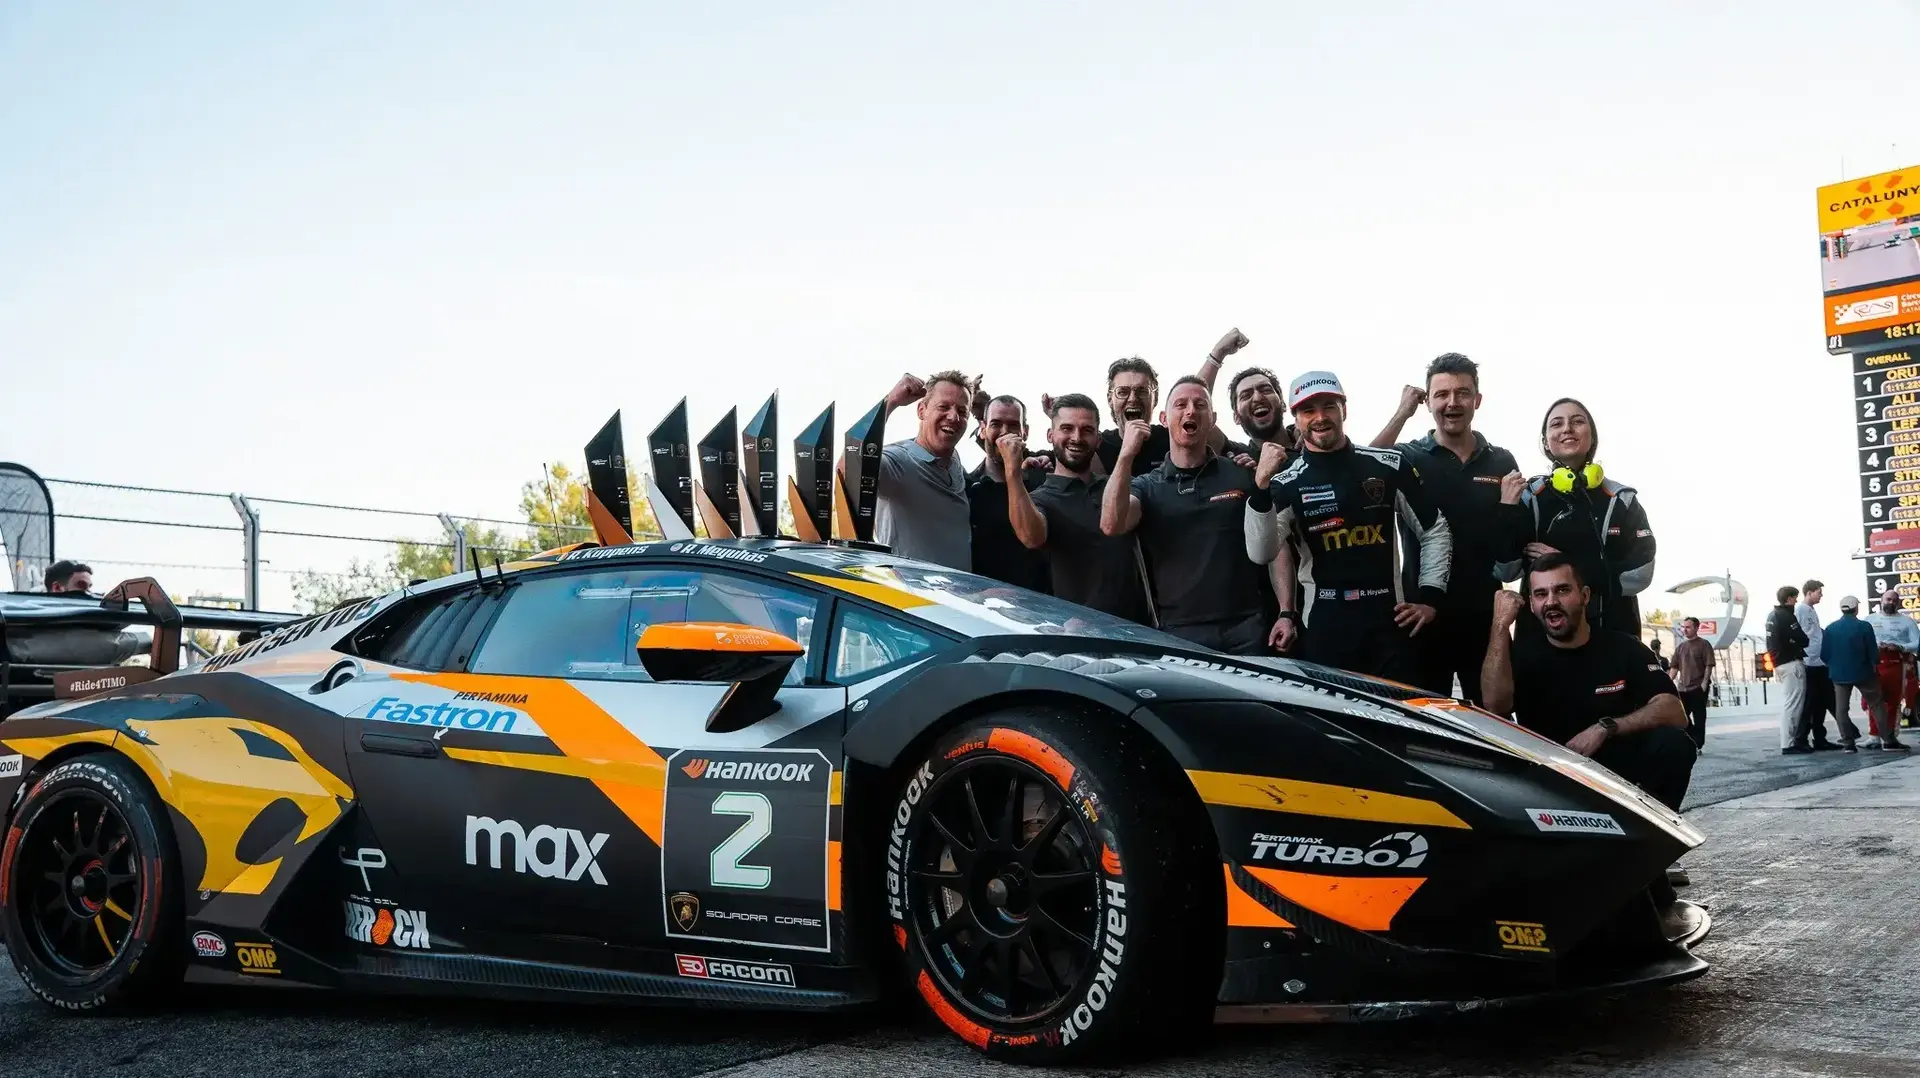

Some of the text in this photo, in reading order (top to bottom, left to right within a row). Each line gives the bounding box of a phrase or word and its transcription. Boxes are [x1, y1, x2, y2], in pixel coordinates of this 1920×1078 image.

[1865, 352, 1911, 366] OVERALL
[1886, 366, 1917, 380] ORU
[1863, 377, 1872, 392] 1
[1892, 392, 1915, 405] ALI
[1864, 402, 1876, 418] 2
[1892, 418, 1918, 430] LEF
[1865, 427, 1877, 442] 3
[1866, 452, 1879, 467] 4
[1868, 477, 1881, 493] 5
[1304, 505, 1338, 517] Fastron
[1870, 503, 1882, 518] 6
[1322, 524, 1386, 551] max
[566, 543, 649, 561] R. Kuppens
[681, 544, 768, 563] R. Meyuhas
[1875, 579, 1887, 594] 9
[70, 675, 126, 692] #Ride4TIMO
[453, 691, 528, 704] PERTAMINA
[366, 697, 517, 732] Fastron
[711, 791, 773, 889] 2
[1253, 832, 1323, 845] PERTAMAX
[466, 815, 610, 886] max
[1251, 841, 1400, 867] TURBO
[706, 910, 822, 927] SQUADRA CORSE
[1498, 924, 1546, 946] OMP
[196, 937, 223, 951] BMC
[237, 947, 277, 968] OMP
[708, 962, 791, 982] FACOM
